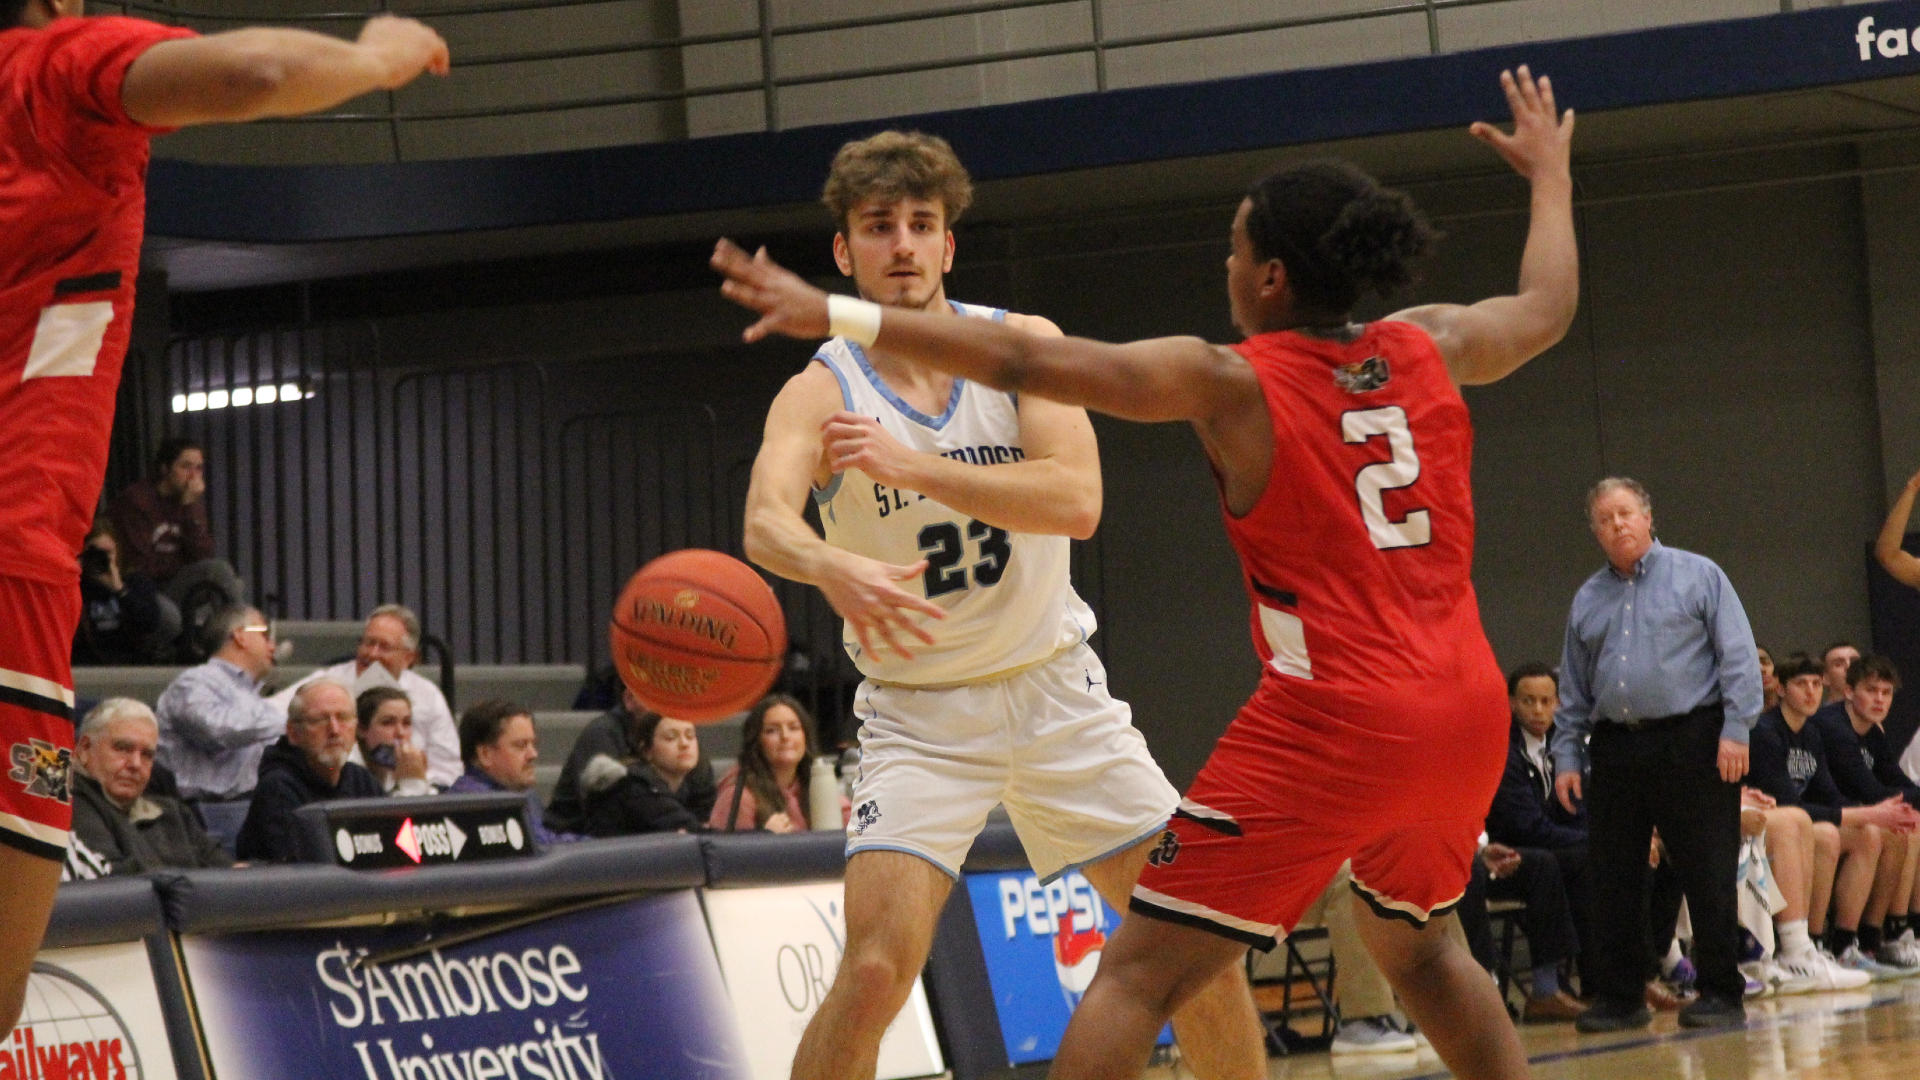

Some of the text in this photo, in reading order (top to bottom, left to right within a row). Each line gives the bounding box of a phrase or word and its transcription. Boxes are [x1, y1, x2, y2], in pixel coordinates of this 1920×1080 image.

[1340, 404, 1432, 551] 2
[917, 520, 1012, 600] 23
[411, 823, 451, 856] POSS
[999, 873, 1105, 942] PEPSI
[353, 1018, 604, 1080] University
